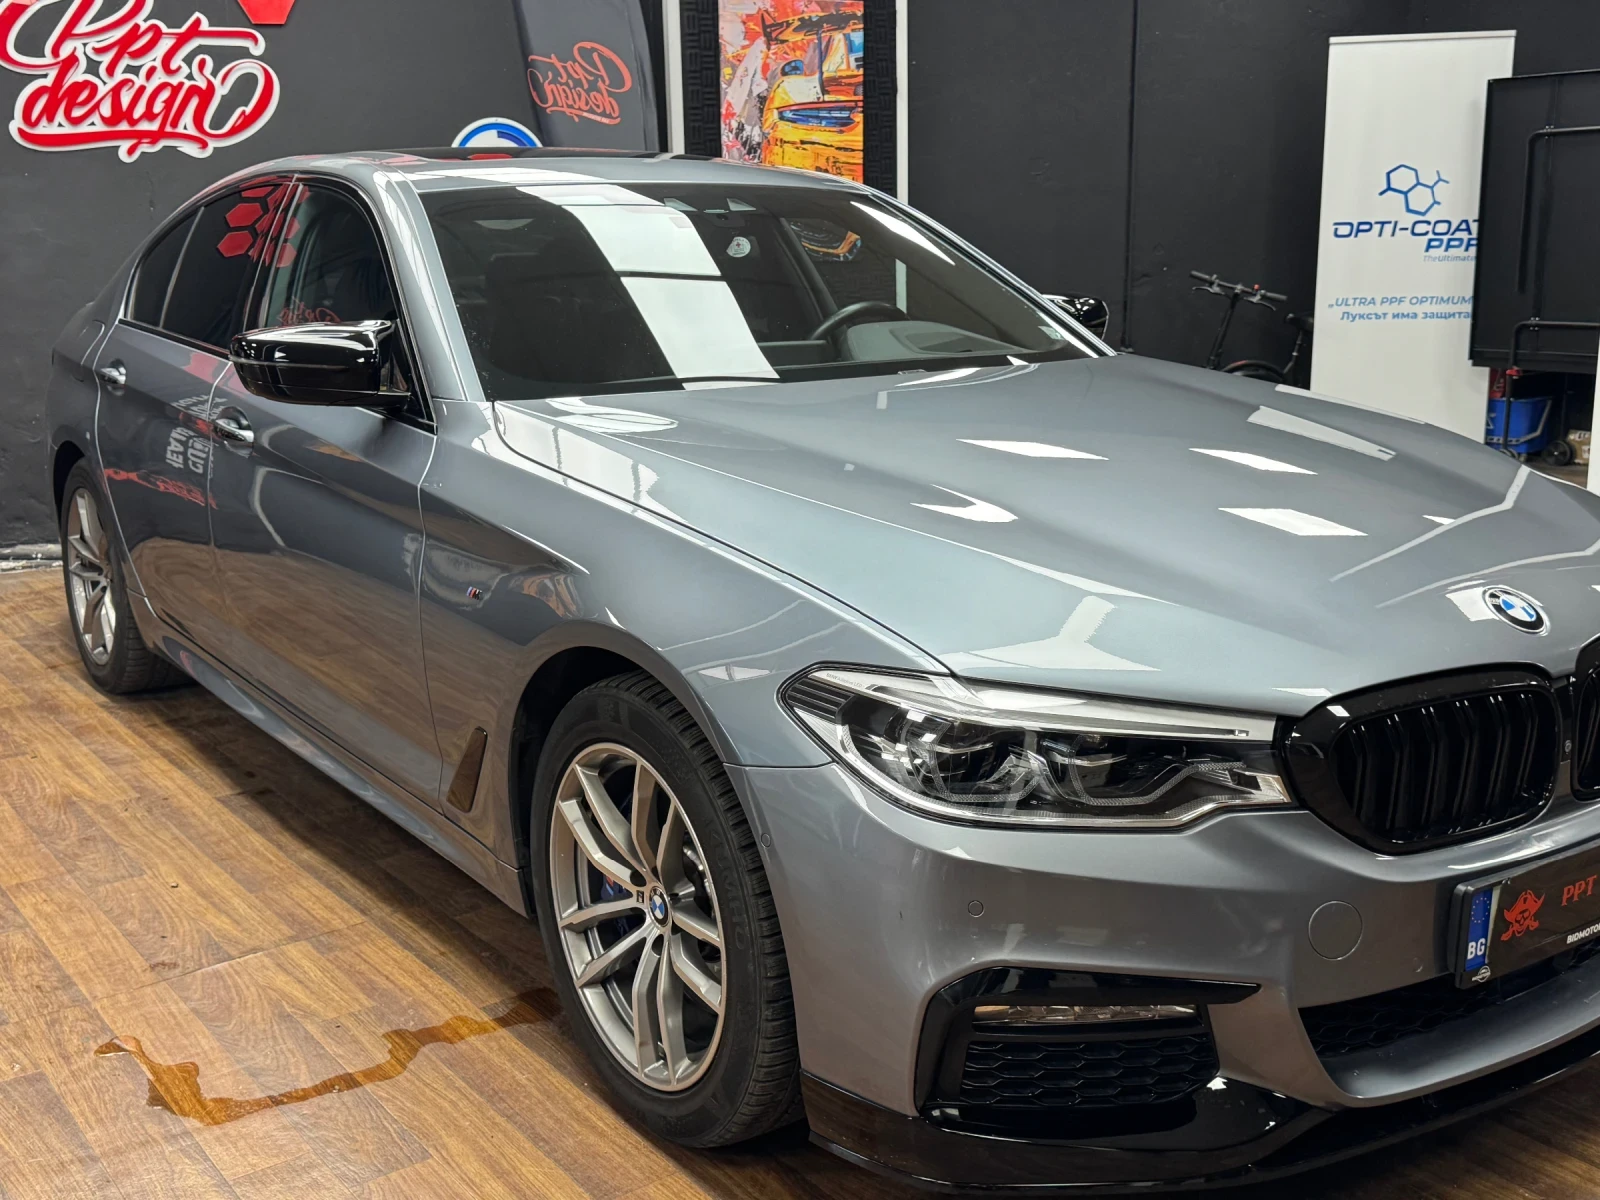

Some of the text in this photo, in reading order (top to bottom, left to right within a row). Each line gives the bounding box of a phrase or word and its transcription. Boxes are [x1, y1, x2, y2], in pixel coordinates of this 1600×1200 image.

[14, 50, 277, 159] design
[1379, 296, 1406, 306] PPF
[1340, 311, 1388, 322] Луксът
[1391, 311, 1418, 320] има
[1561, 874, 1597, 907] PPT
[1466, 937, 1486, 960] BG
